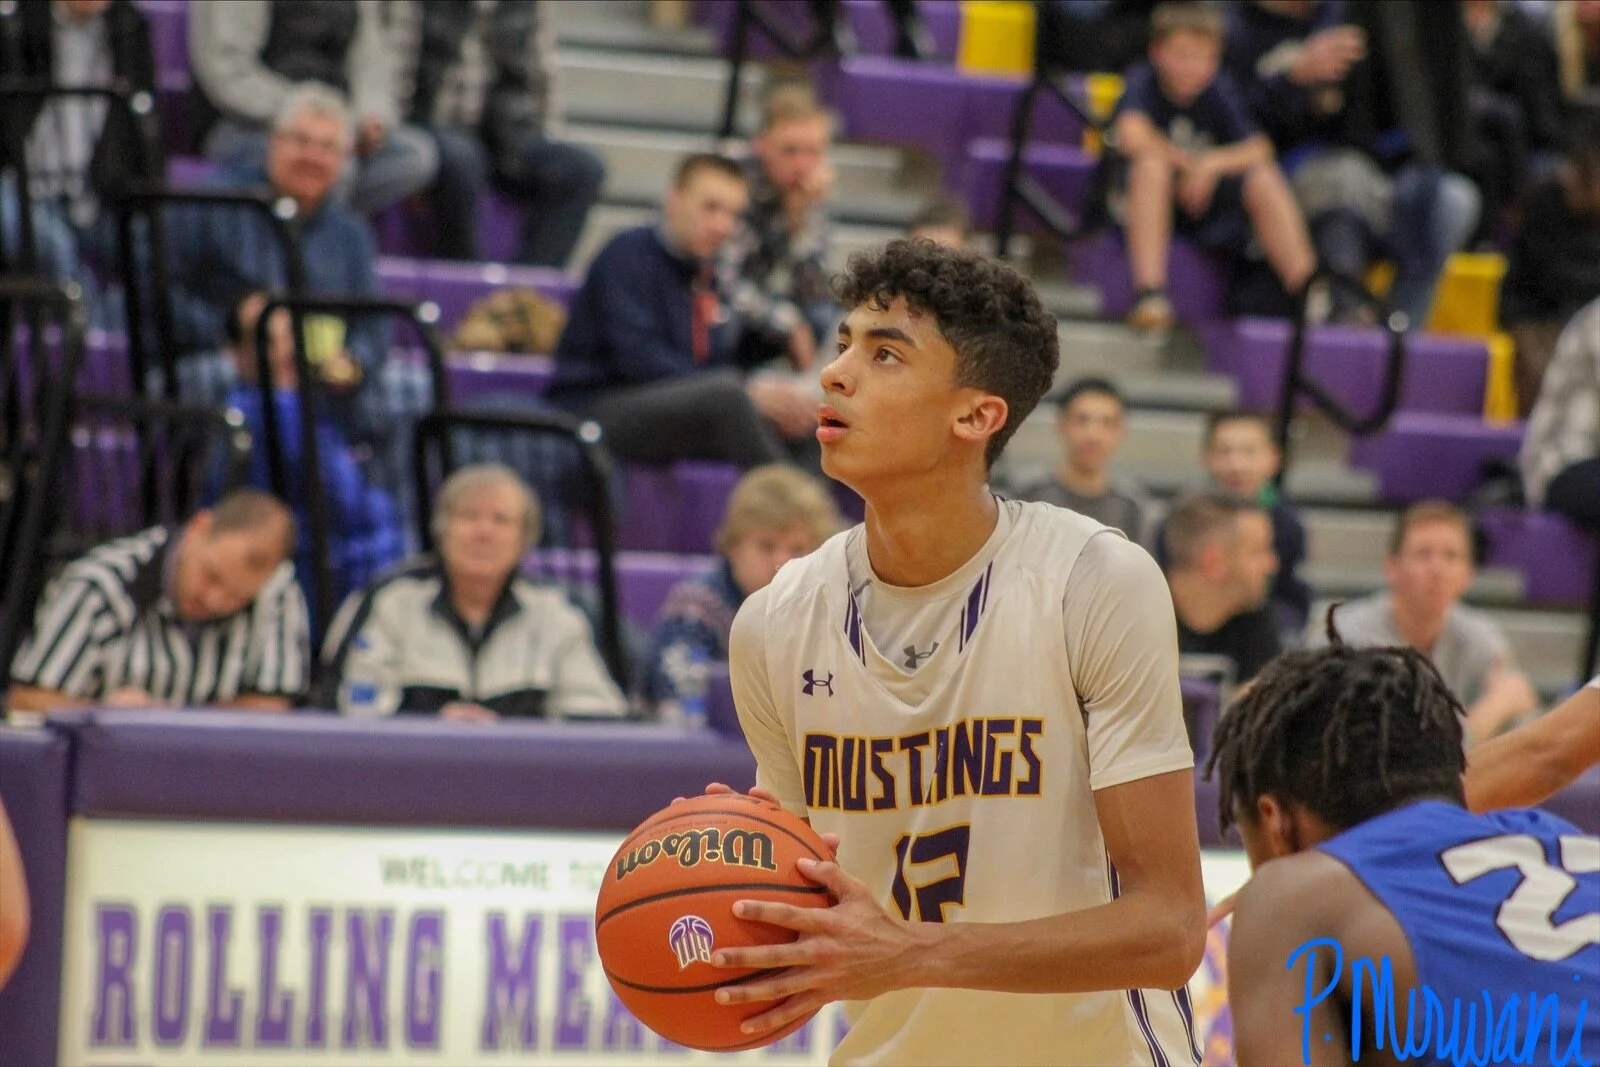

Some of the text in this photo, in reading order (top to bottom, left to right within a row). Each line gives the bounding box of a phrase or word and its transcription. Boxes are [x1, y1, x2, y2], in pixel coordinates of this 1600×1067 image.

[803, 716, 1045, 814] MUSTANGS
[616, 827, 777, 882] Wilson
[1437, 832, 1600, 962] 2
[88, 903, 444, 1050] ROLLING
